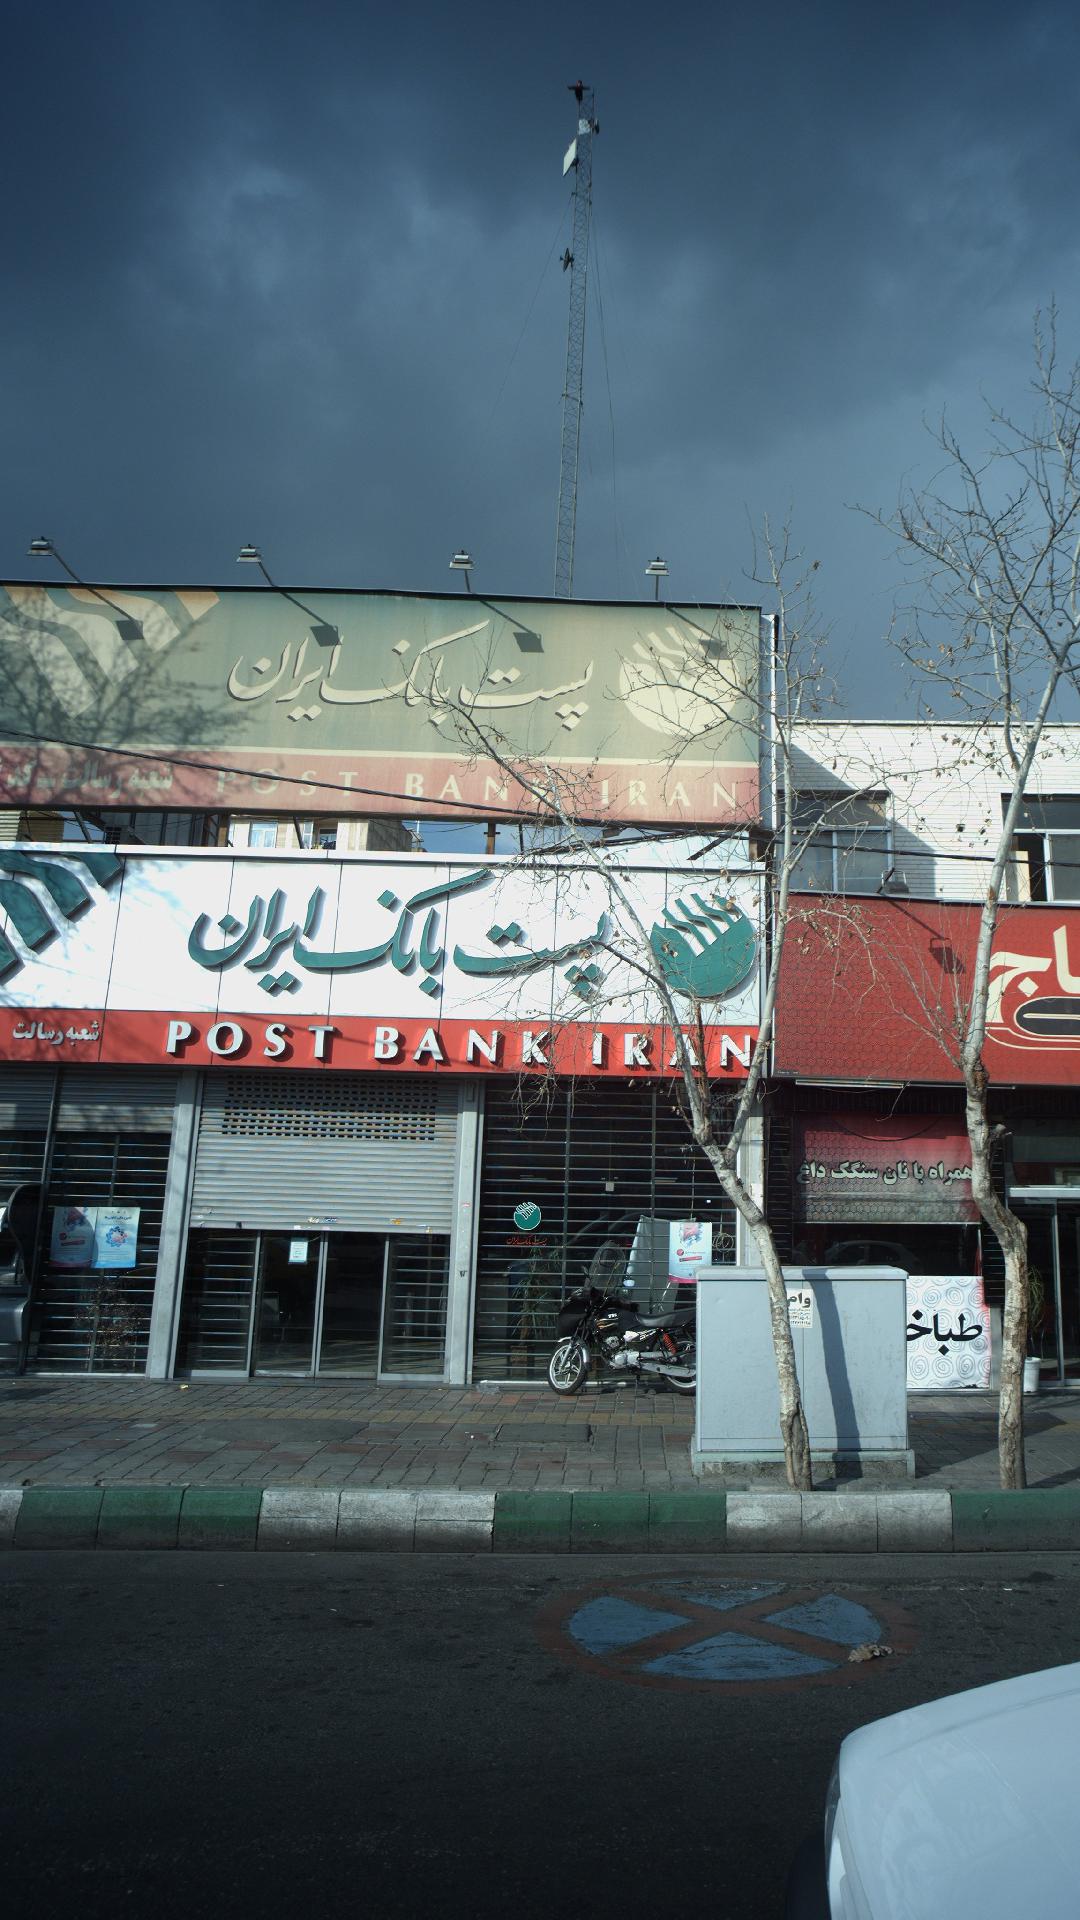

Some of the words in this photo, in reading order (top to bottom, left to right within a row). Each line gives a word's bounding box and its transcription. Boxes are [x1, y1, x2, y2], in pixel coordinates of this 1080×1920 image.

[227, 634, 344, 722] ایران
[319, 619, 490, 727] بانک
[458, 660, 594, 731] پست
[217, 767, 359, 797] POST
[404, 772, 554, 805] BANK
[601, 778, 739, 809] IRAN
[188, 885, 326, 997] ایران
[293, 868, 494, 999] بانک
[453, 910, 612, 1001] پست
[984, 924, 1080, 1024] اج
[13, 1021, 63, 1045] رسالت
[66, 1020, 99, 1046] شعبه
[167, 1019, 334, 1058] POST
[374, 1026, 549, 1065] BANK
[591, 1032, 751, 1068] IRAN
[796, 1159, 826, 1184] داغ
[831, 1160, 880, 1179] سنگک
[883, 1160, 910, 1185] نان
[912, 1160, 925, 1184] با
[927, 1160, 973, 1186] همراه
[906, 1309, 983, 1356] طباخ
